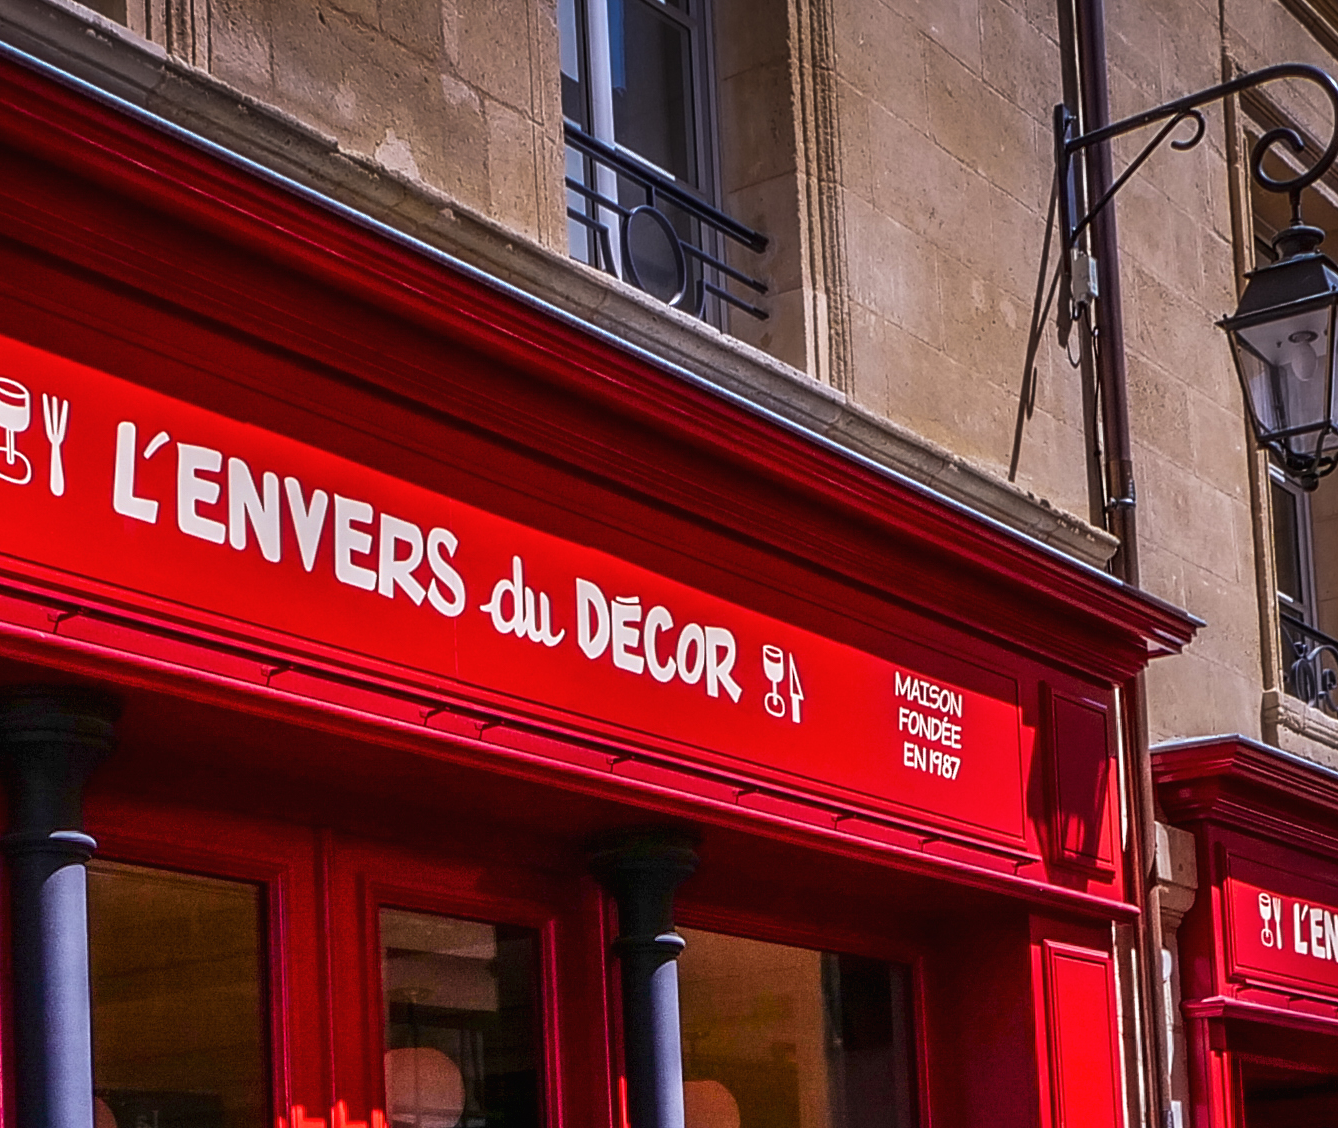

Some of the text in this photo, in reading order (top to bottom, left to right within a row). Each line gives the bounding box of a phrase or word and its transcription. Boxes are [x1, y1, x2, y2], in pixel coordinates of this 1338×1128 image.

[112, 420, 742, 703] L'ENVERS du DÉCOR
[895, 671, 962, 718] MAISON
[899, 706, 962, 749] FONDÉE
[904, 741, 961, 780] EN 1987
